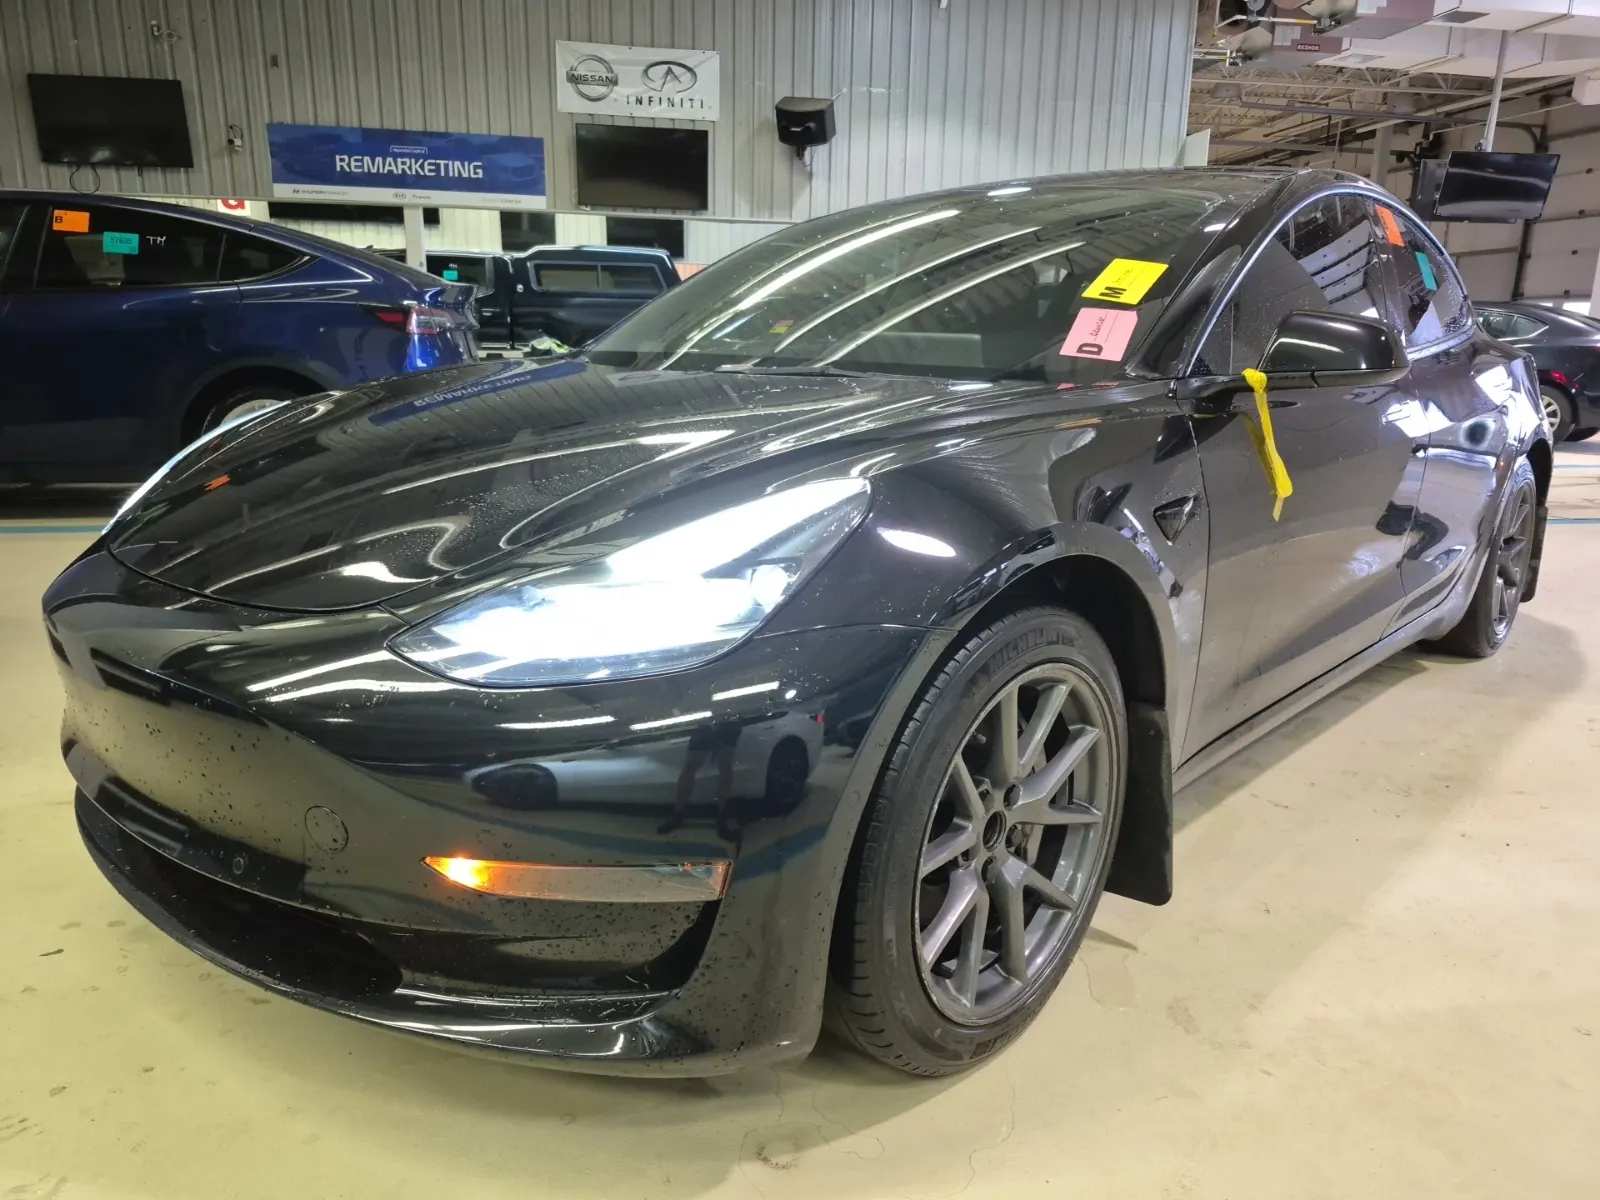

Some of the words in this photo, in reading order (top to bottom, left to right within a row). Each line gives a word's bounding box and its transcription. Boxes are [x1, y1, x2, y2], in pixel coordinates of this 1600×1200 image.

[571, 73, 614, 84] NISSAN
[626, 95, 704, 109] INFINITI
[335, 154, 484, 179] REMARKETING
[54, 215, 63, 224] B
[1098, 286, 1127, 299] M
[1076, 342, 1104, 356] D
